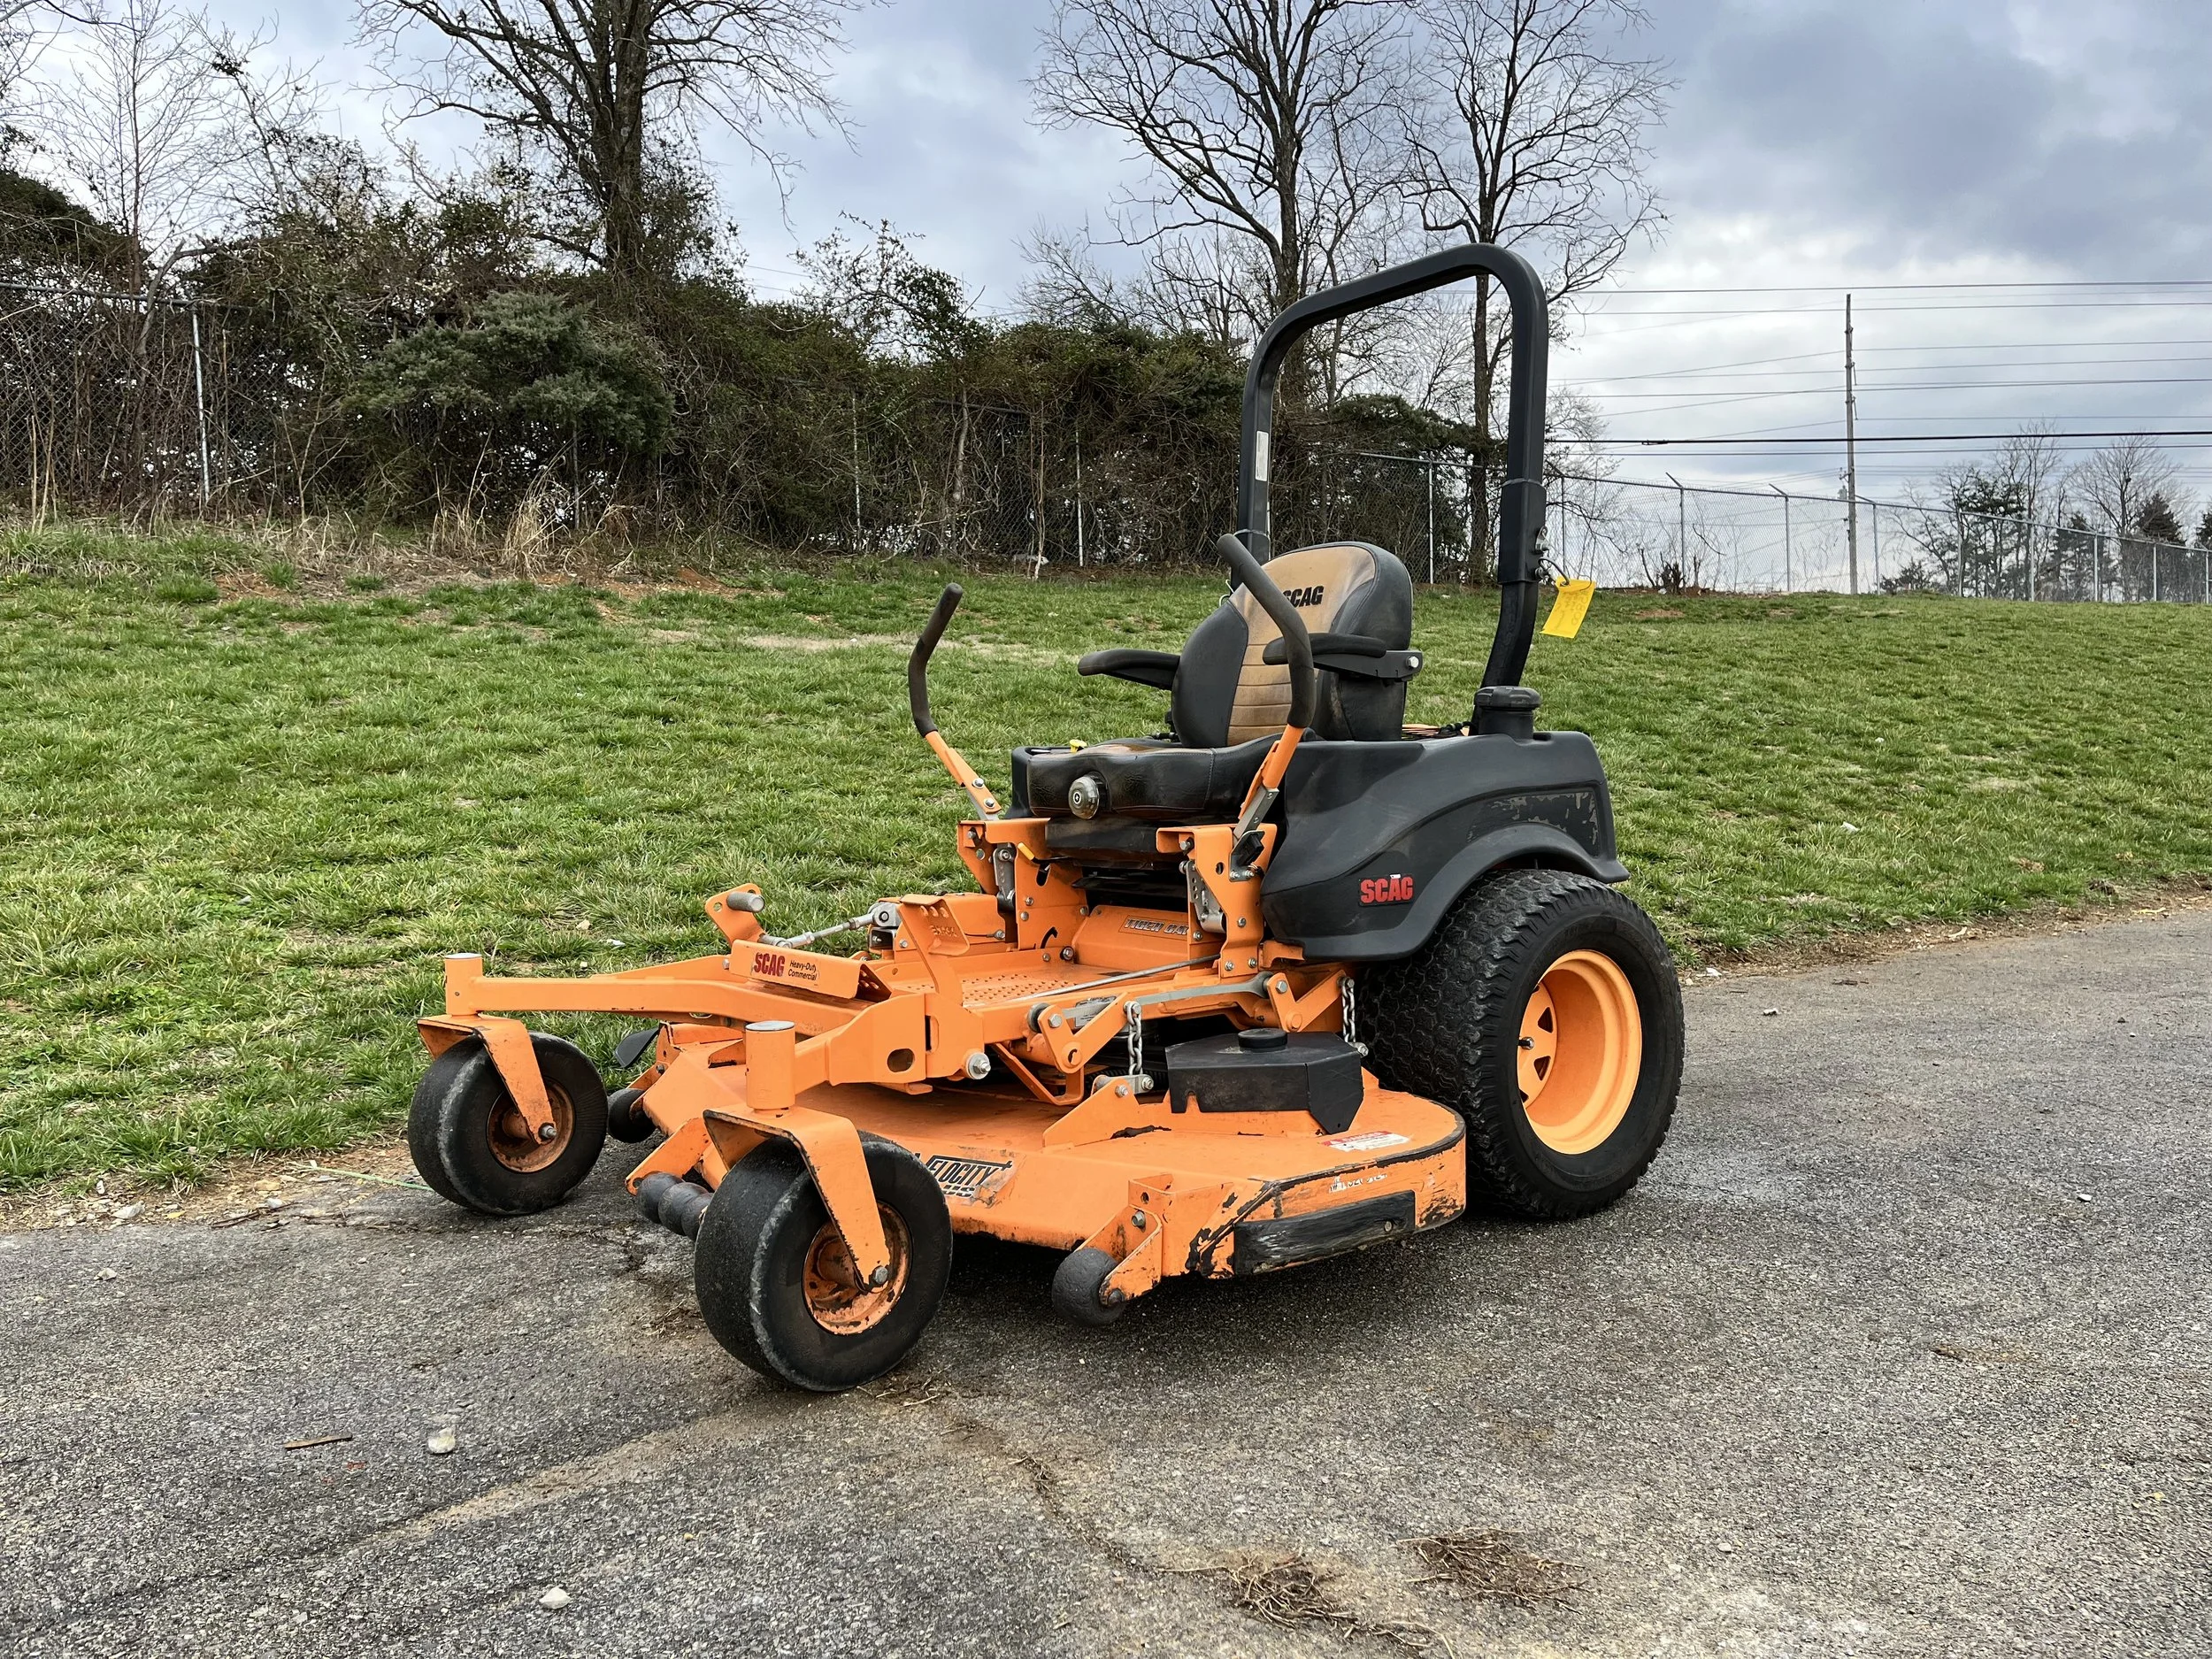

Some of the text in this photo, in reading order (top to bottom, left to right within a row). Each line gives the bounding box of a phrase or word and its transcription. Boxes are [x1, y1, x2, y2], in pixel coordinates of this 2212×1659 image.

[1360, 876, 1413, 903] SCAG
[754, 952, 786, 977] SCAG
[787, 969, 818, 981] Commercial
[915, 1153, 1000, 1186] ELOCITY
